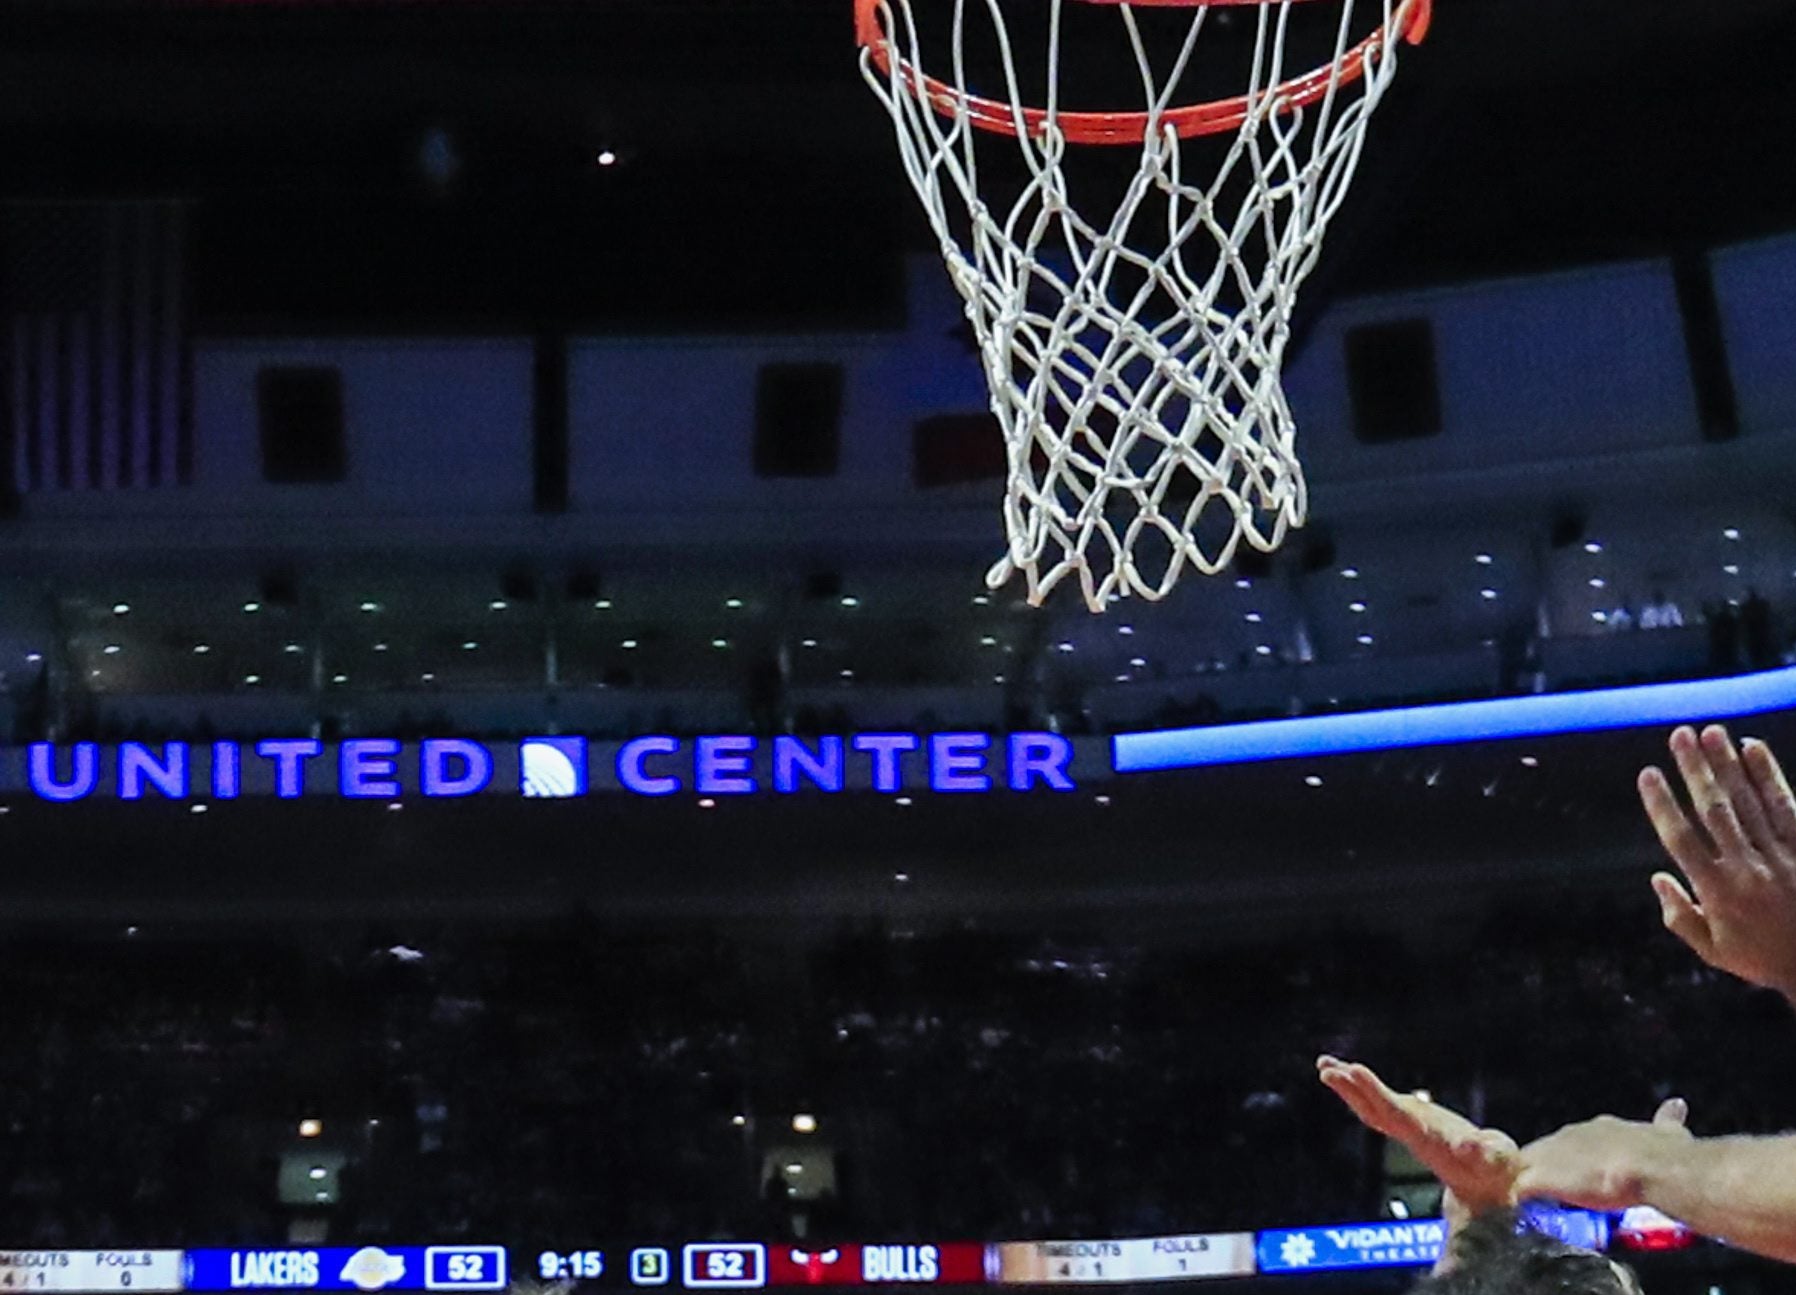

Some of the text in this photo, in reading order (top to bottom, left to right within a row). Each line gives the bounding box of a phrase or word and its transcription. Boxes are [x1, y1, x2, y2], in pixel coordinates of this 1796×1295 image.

[28, 732, 1075, 800] UNITED CENTER
[1036, 1237, 1210, 1258] TIMEOUTS FOULS
[1325, 1224, 1443, 1249] VIDANTA
[96, 1253, 153, 1267] FOULS
[231, 1251, 483, 1288] LAKERS 52
[540, 1251, 604, 1279] 9:15
[643, 1254, 658, 1276] 3
[708, 1245, 938, 1281] 52 BULLS
[120, 1271, 131, 1287] 0
